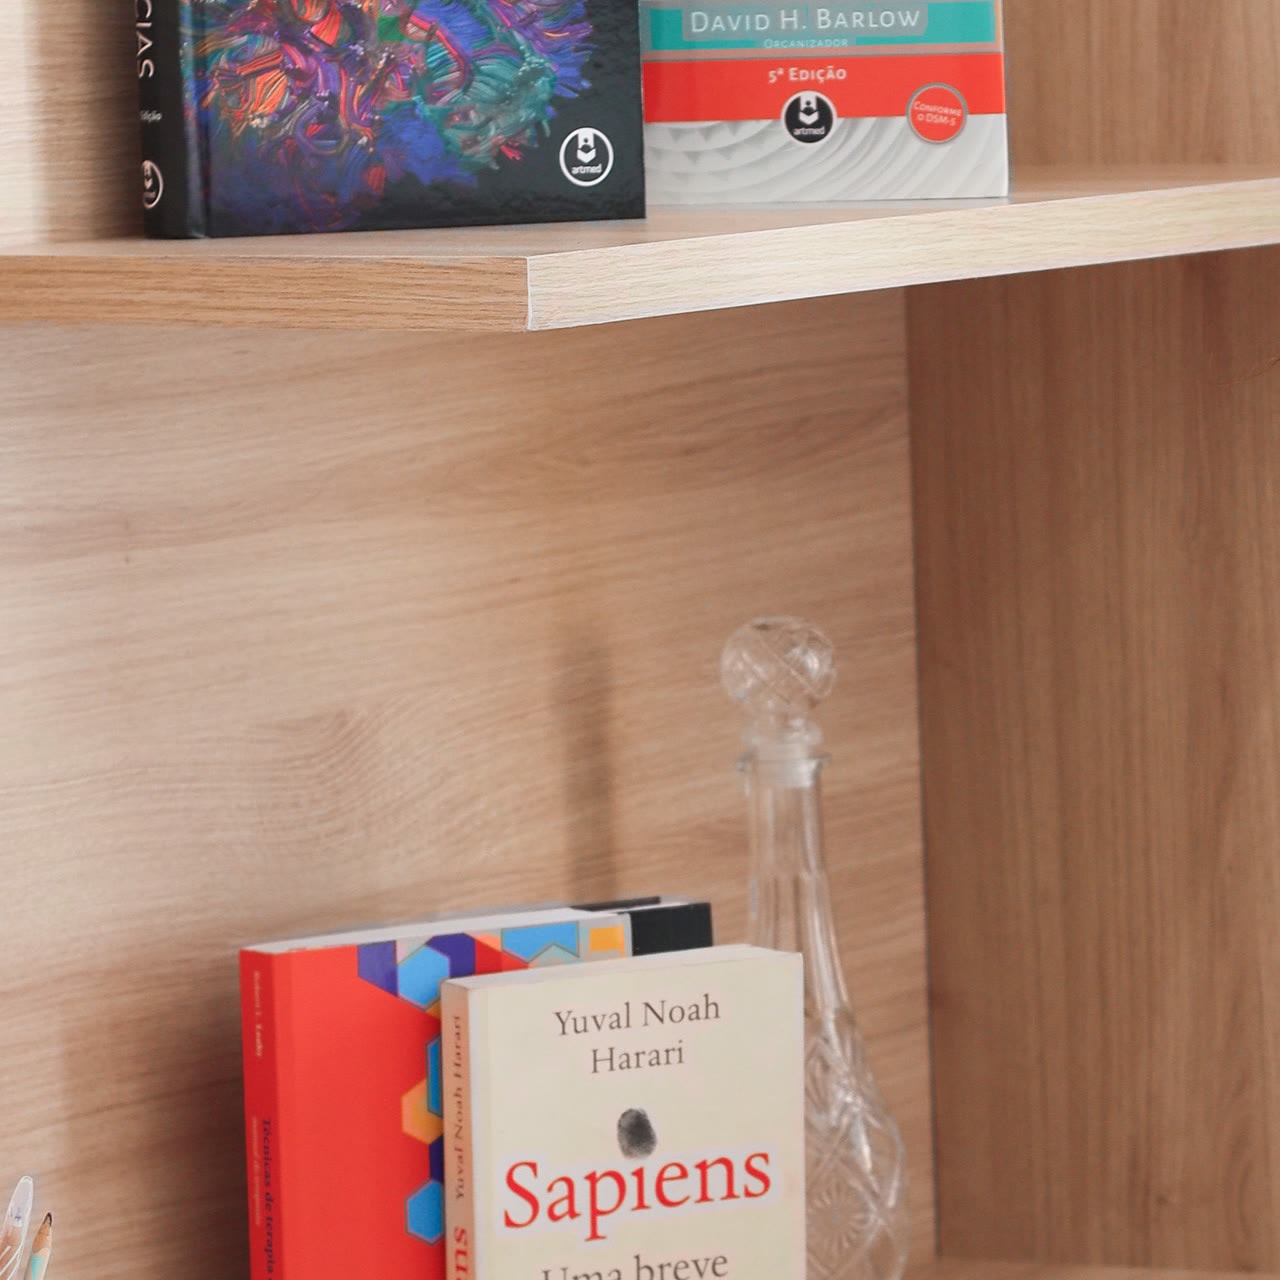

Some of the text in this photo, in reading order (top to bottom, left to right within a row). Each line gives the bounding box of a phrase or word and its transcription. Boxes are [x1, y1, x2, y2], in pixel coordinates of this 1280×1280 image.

[690, 7, 921, 34] DAVID H. BARLOW
[571, 163, 603, 175] artmed
[553, 993, 722, 1038] Yuval Noah
[590, 1039, 685, 1075] Harari
[453, 1086, 465, 1141] Noah
[454, 1145, 466, 1201] Yuval
[504, 1150, 772, 1243] Sapiens
